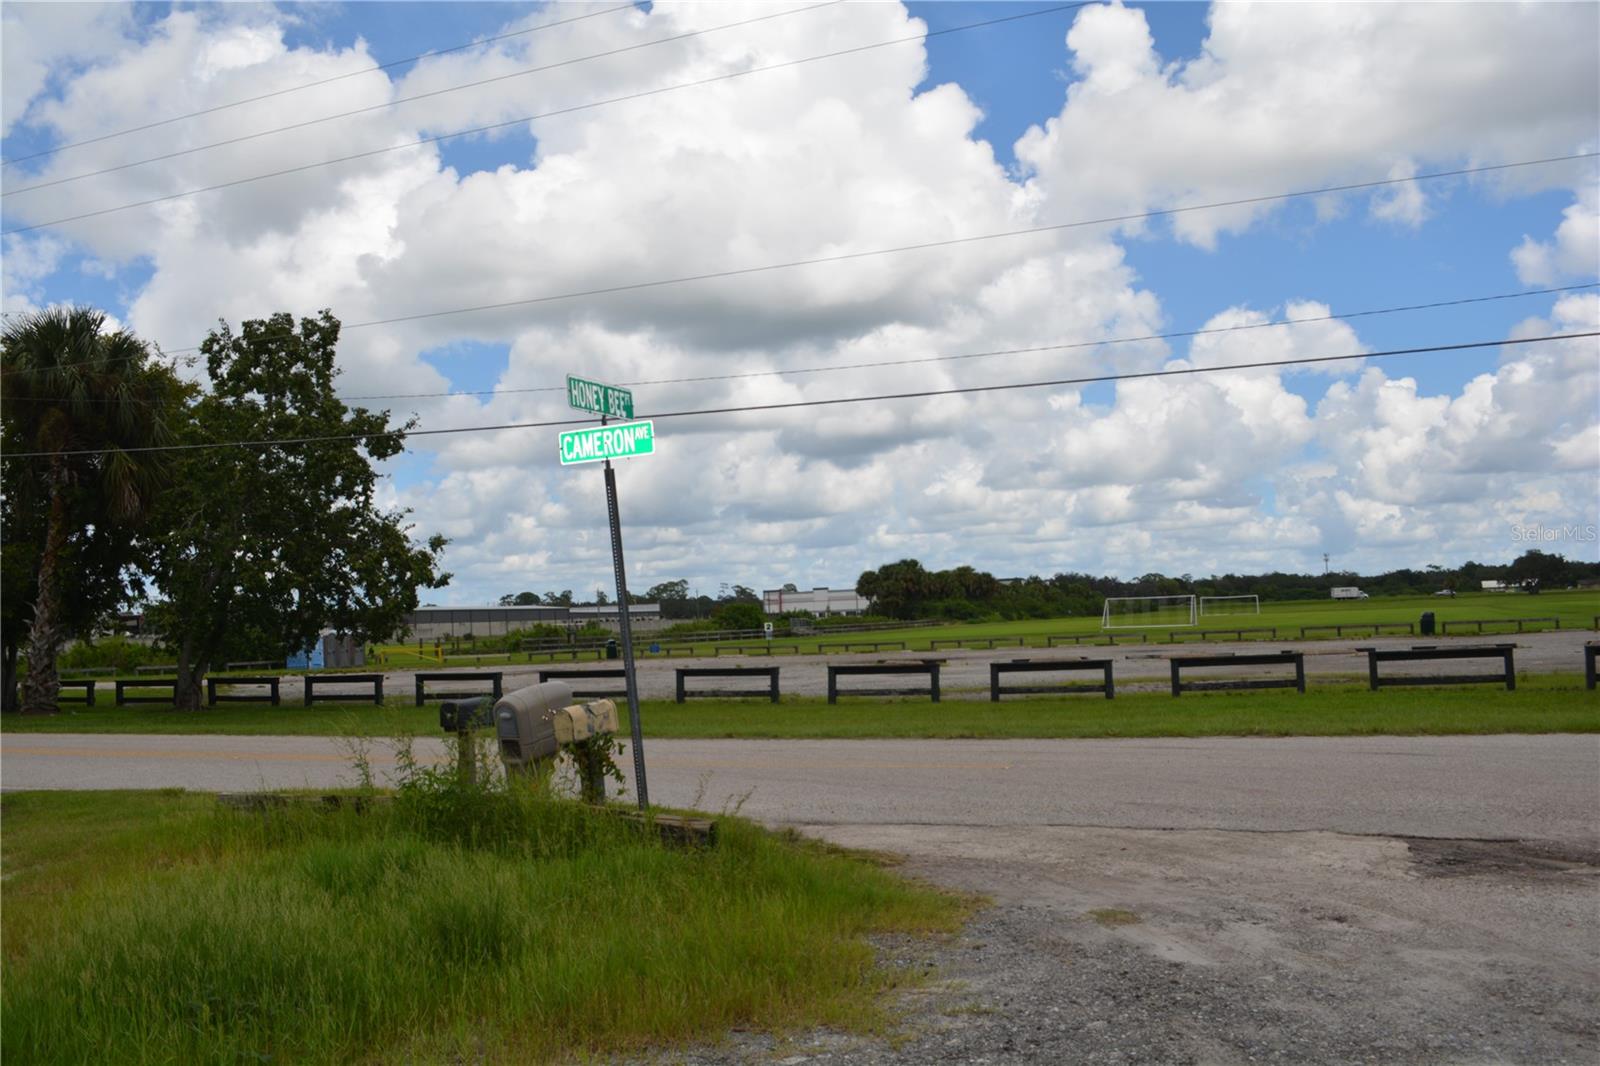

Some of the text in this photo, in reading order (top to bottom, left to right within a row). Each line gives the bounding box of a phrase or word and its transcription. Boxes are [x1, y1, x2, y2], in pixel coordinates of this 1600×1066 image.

[570, 380, 604, 411] HONEY
[608, 389, 627, 418] BEE
[563, 426, 649, 460] CAMERON AVE
